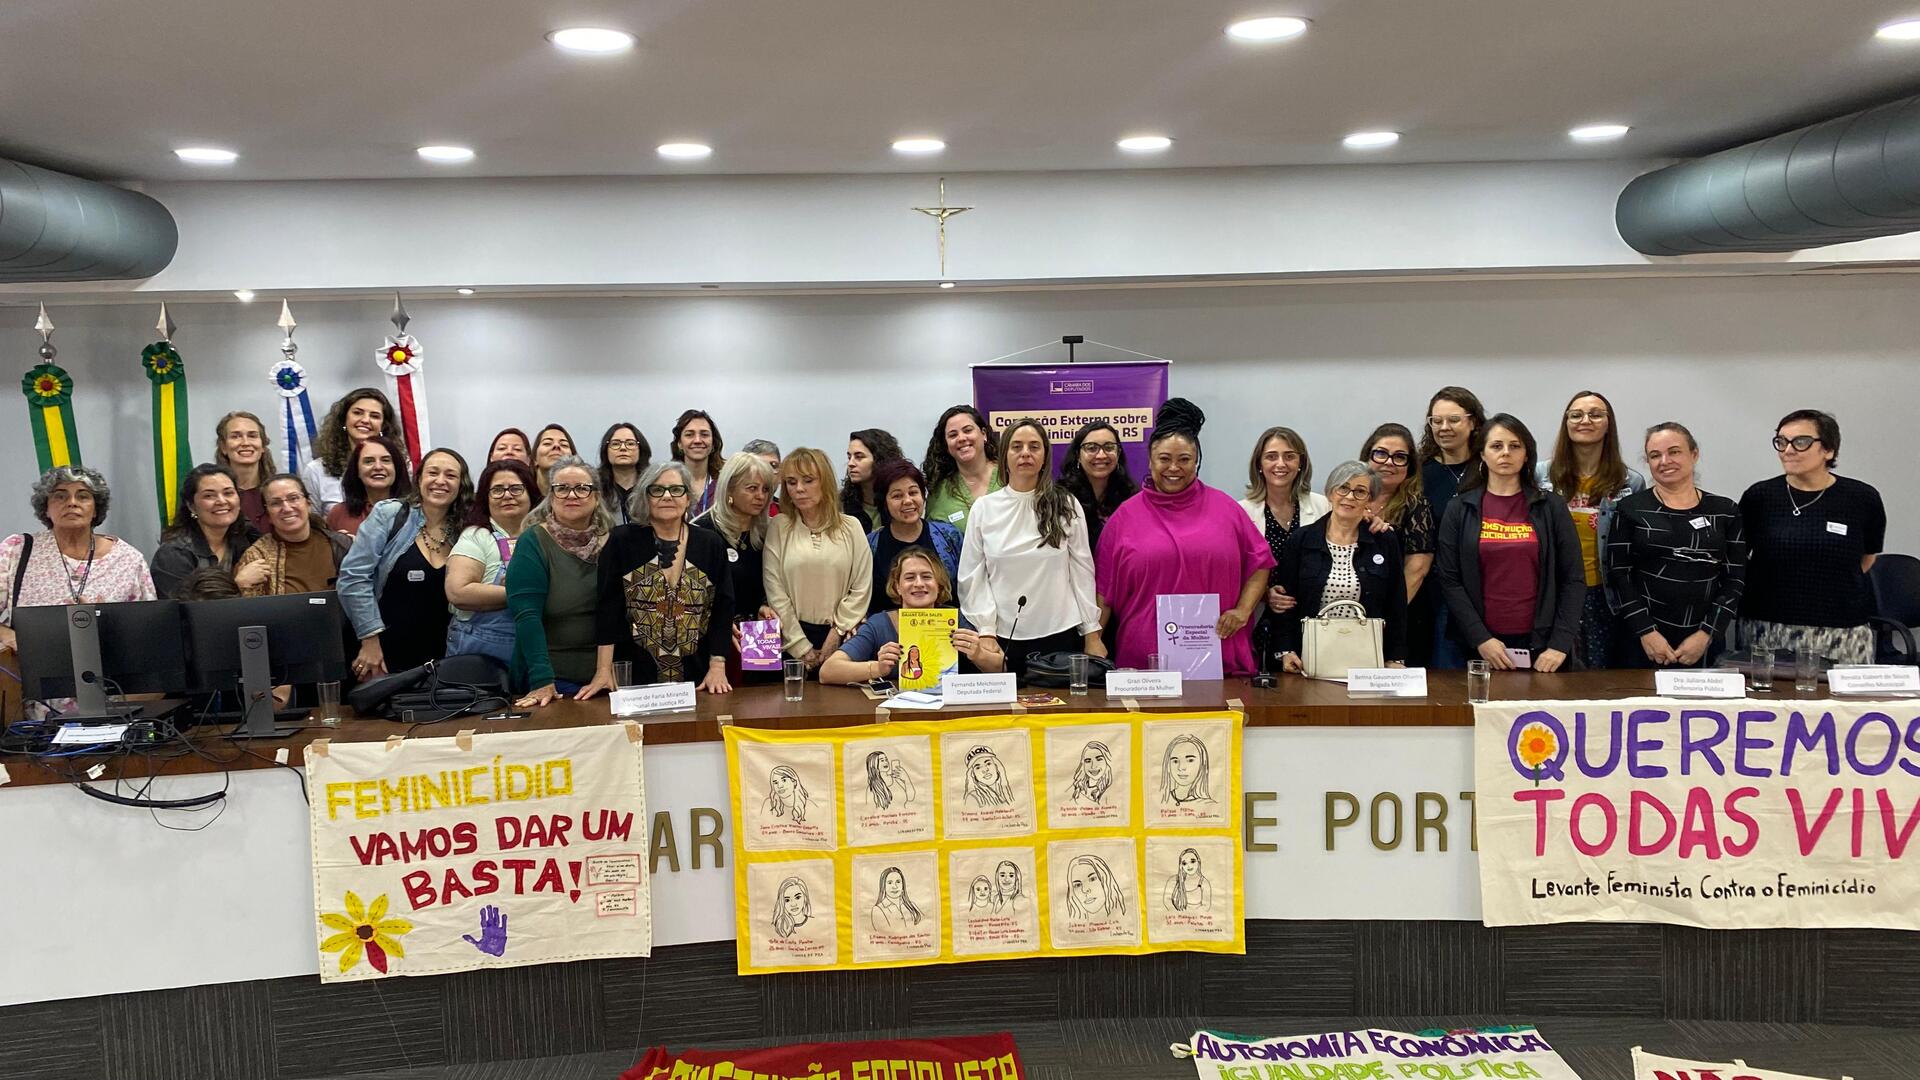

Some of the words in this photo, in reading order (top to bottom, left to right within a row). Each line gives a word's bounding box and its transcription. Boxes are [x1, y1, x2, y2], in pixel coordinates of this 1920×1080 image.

[1113, 413, 1148, 424] sobre
[1122, 427, 1138, 437] RS
[1482, 521, 1533, 532] ONSTRUÇÃO
[325, 755, 574, 821] FEMINICÍDIO
[350, 822, 478, 866] VAMOS
[495, 814, 572, 851] DAR
[582, 810, 634, 842] UM
[1325, 791, 1478, 852] PORT
[1512, 786, 1760, 860] TODAS
[1785, 786, 1920, 860] VIV
[402, 858, 583, 911] BASTA!
[1531, 877, 1600, 899] Levante
[1606, 870, 1693, 899] Feminista
[1699, 874, 1756, 900] Contra
[1762, 885, 1774, 897] o
[1777, 872, 1877, 898] Feminicídio
[1195, 1030, 1369, 1062] AUTONOMIA
